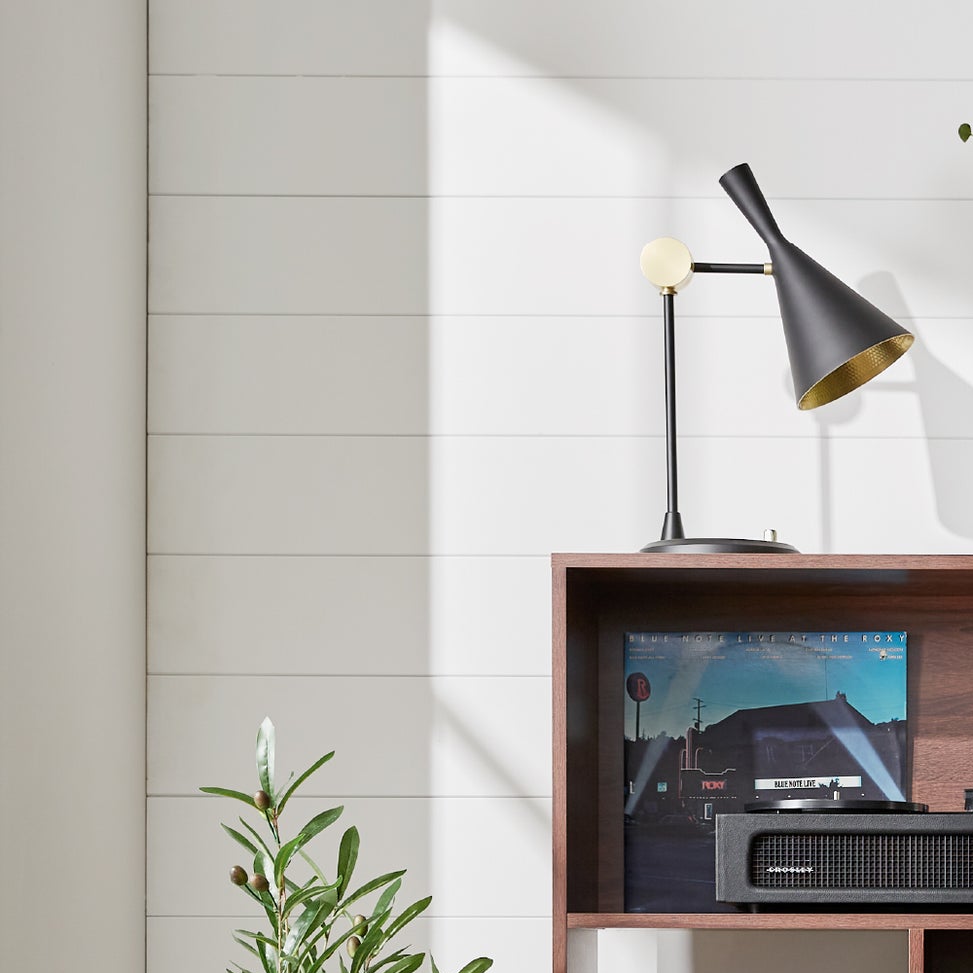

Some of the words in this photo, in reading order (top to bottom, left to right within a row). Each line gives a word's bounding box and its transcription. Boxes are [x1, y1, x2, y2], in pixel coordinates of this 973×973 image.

[629, 634, 668, 643] BLUE
[682, 634, 725, 643] NOTE
[737, 634, 776, 643] LIVE
[789, 634, 806, 643] AT
[820, 634, 849, 643] THE
[862, 634, 905, 643] ROXY
[702, 781, 725, 790] ROXY
[774, 780, 788, 788] BLUE
[788, 780, 803, 788] NOTE
[803, 779, 816, 788] LIVE
